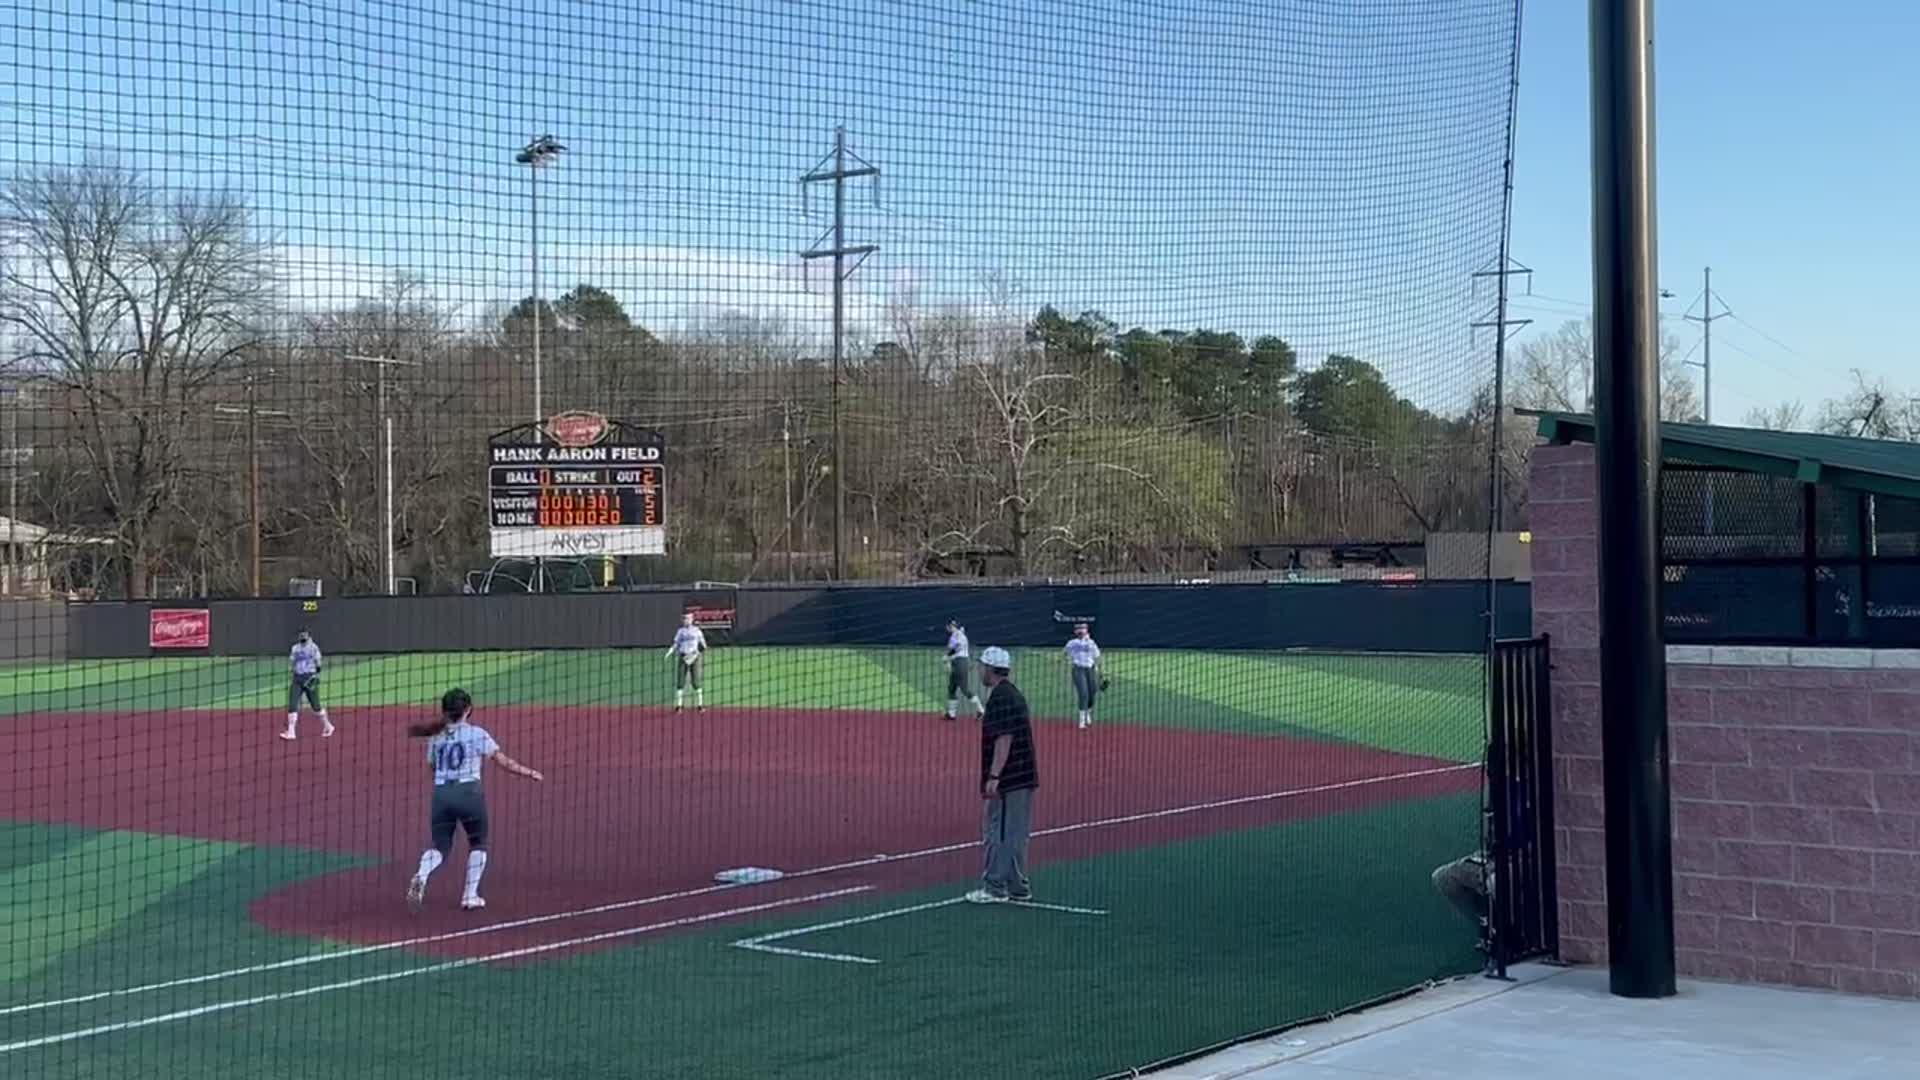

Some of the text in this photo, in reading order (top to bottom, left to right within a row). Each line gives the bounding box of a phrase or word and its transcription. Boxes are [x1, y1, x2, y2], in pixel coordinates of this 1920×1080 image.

[493, 446, 660, 462] HANK AARON FIELD
[506, 471, 538, 484] BALL
[554, 471, 598, 484] STRIKE
[616, 470, 642, 483] OUT
[492, 496, 538, 510] VISITOR
[496, 512, 535, 525] HOME
[550, 532, 608, 554] ARVEST
[438, 741, 465, 771] 10
